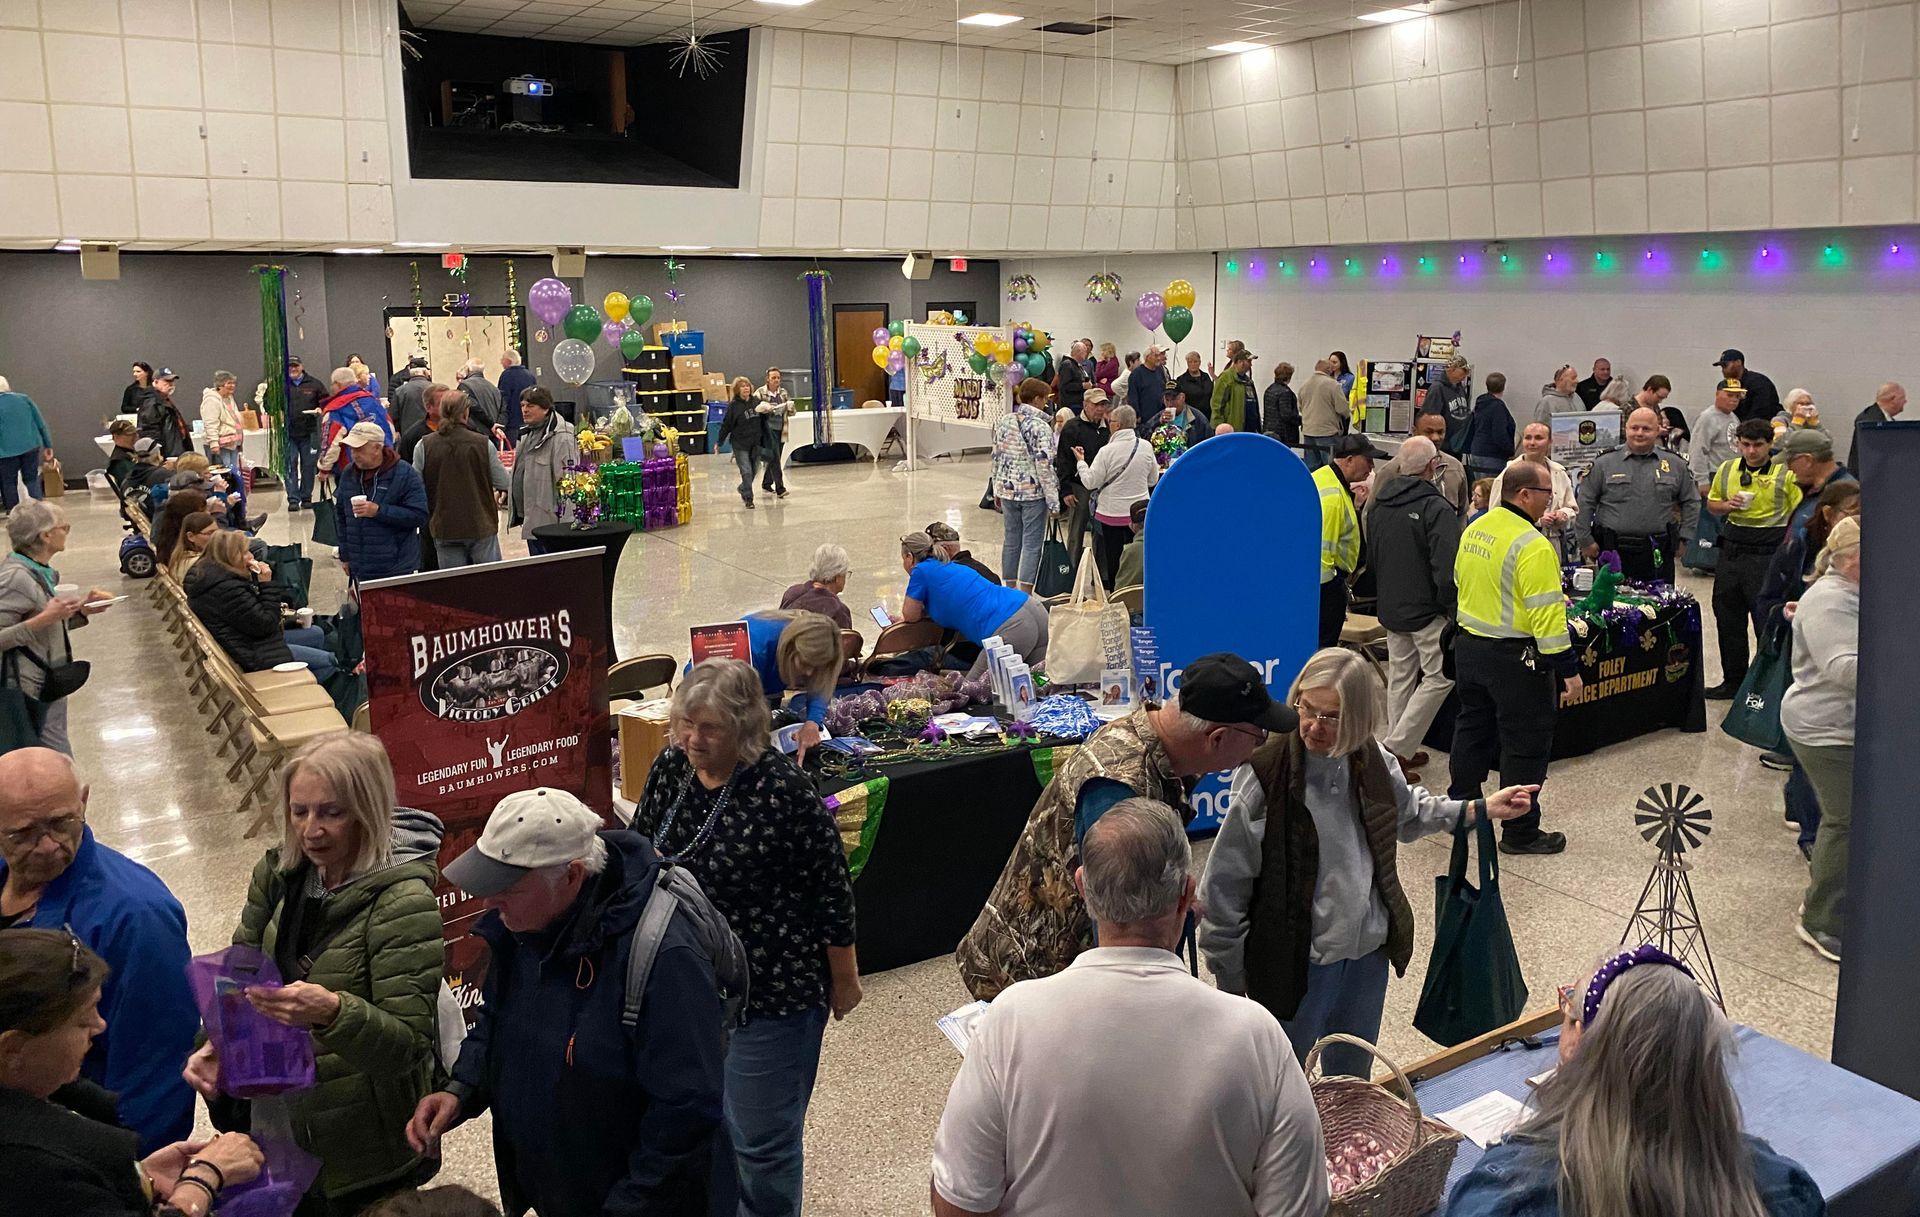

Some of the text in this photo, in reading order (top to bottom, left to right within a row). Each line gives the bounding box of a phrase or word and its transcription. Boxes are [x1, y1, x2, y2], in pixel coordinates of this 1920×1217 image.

[953, 378, 982, 399] MARDI
[955, 398, 980, 419] GRAS
[1467, 530, 1497, 546] SUPPORT
[1464, 542, 1491, 560] SERVICES
[411, 609, 572, 680] BAUMHOWER'S
[1102, 635, 1122, 646] Tanger
[1103, 643, 1124, 654] Tanger
[1106, 651, 1125, 662] Tanger
[1599, 656, 1626, 679] FOLEY
[1598, 667, 1659, 699] DEPARTMENT
[438, 678, 560, 721] VICTORY GRILLE
[417, 762, 469, 785] LEGENDARY
[470, 756, 488, 771] FUN
[506, 741, 554, 762] LEGENDARY
[439, 755, 559, 795] BAUMHOWERS.COM
